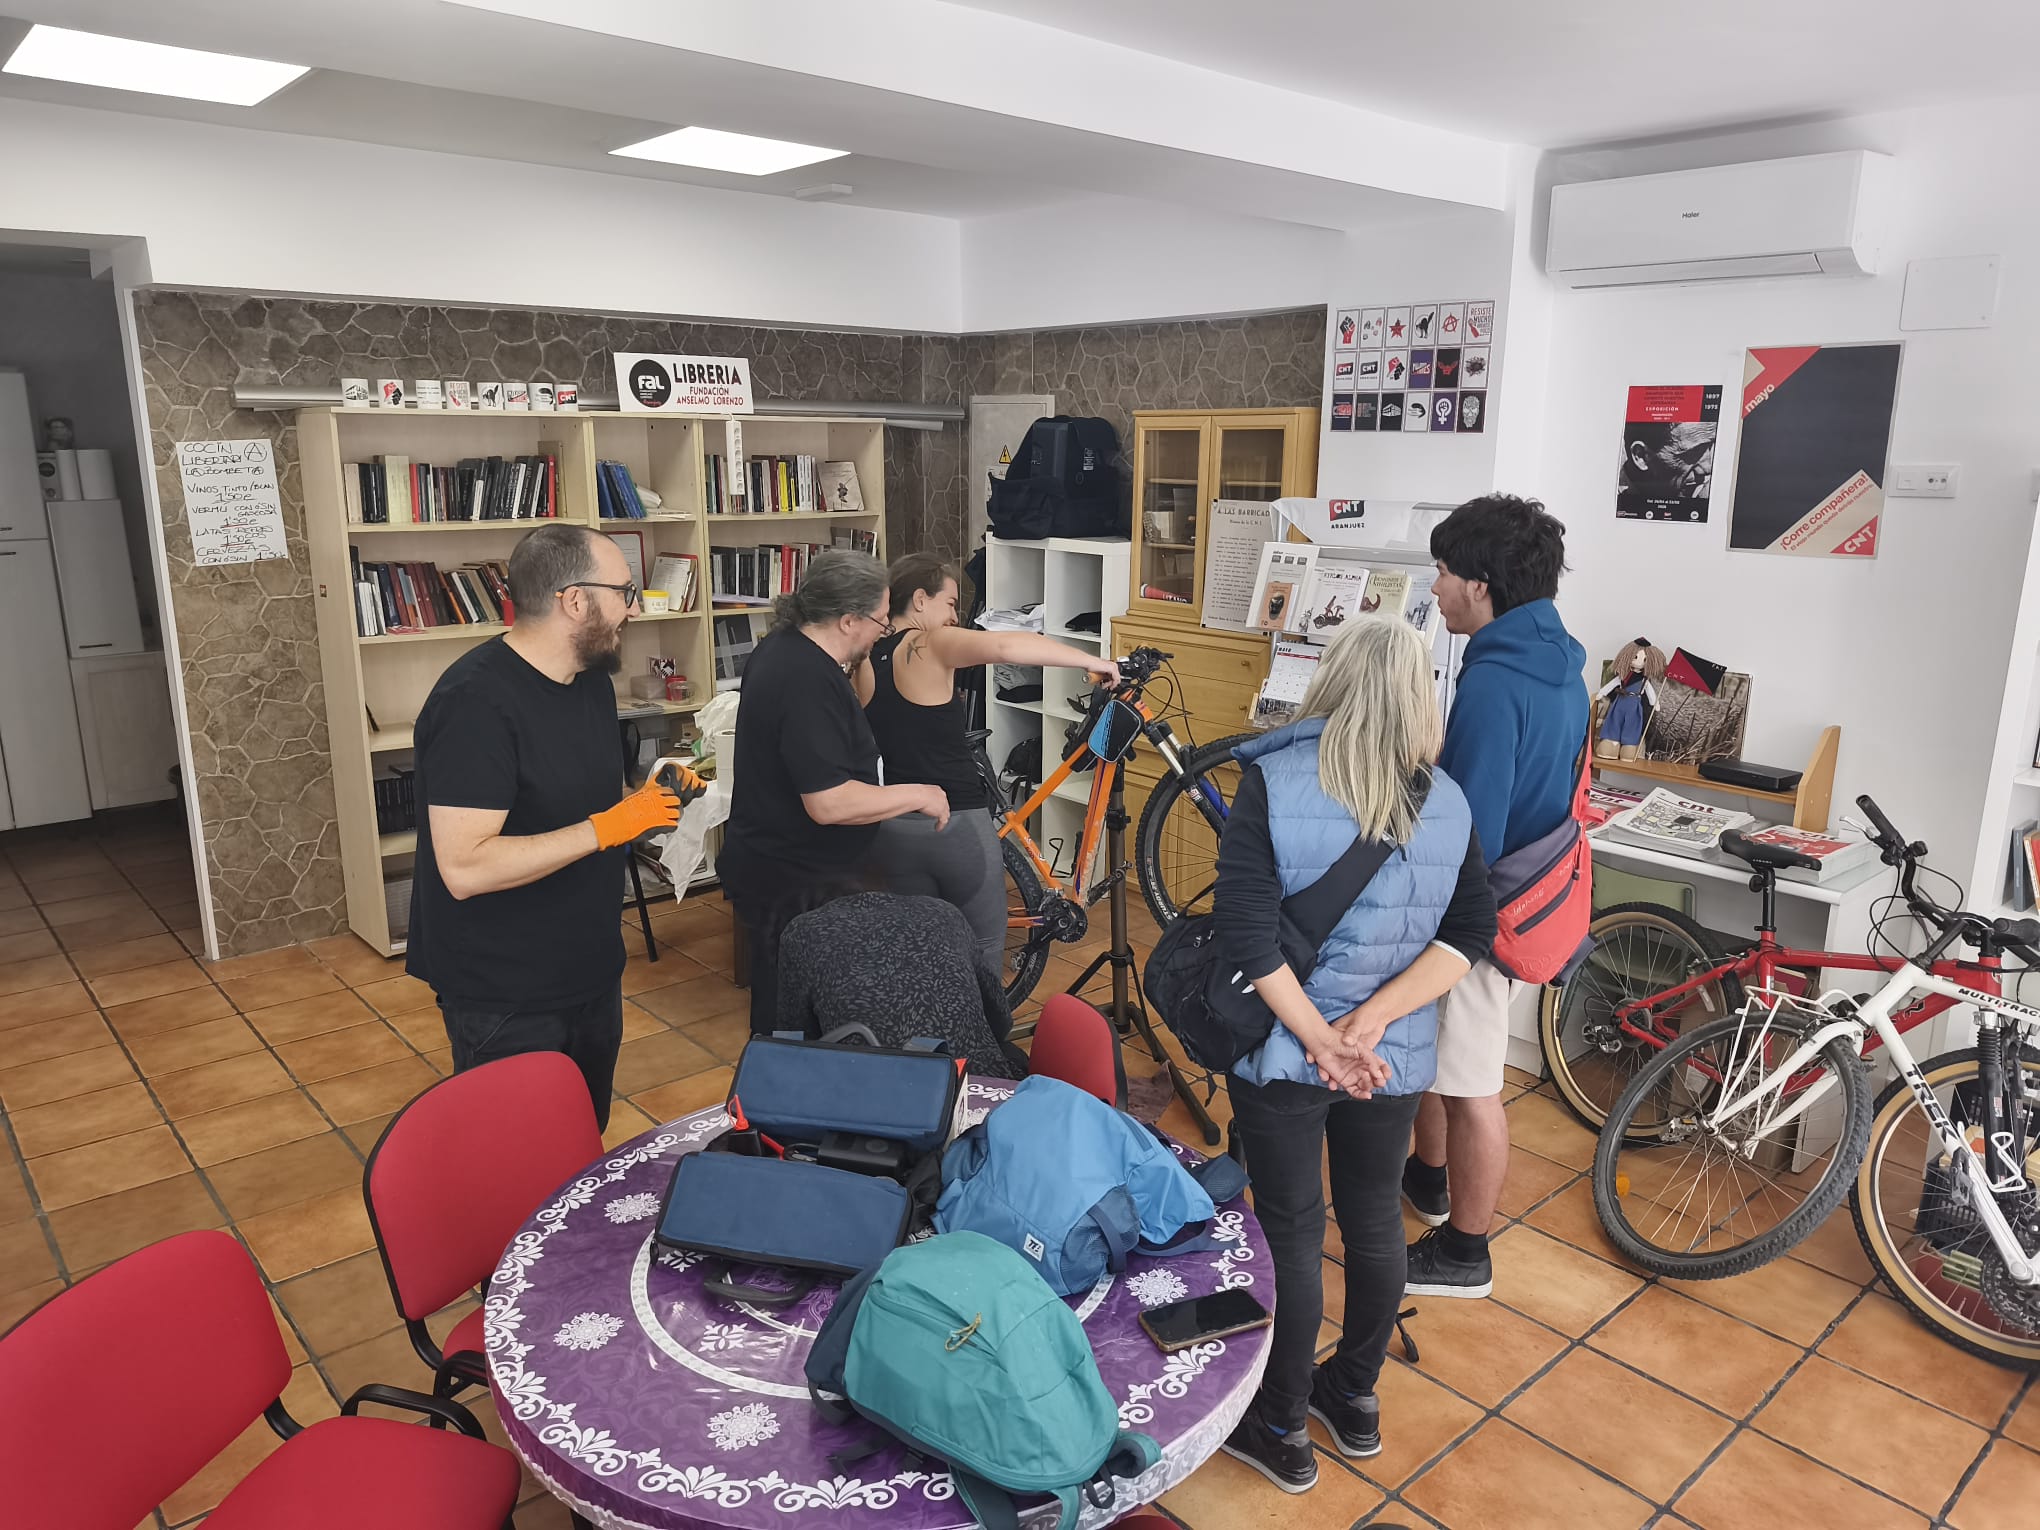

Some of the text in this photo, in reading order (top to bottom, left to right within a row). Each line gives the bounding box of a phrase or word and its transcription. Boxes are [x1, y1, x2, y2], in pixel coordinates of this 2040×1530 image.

[1362, 364, 1376, 372] CNT
[673, 363, 742, 385] LIBRERIA
[690, 386, 729, 396] FUNDACIÓN
[677, 396, 744, 406] ANSELMO LORENZO
[1745, 384, 1775, 413] mayo
[187, 483, 219, 493] VINOS
[234, 504, 253, 512] CON
[1334, 500, 1361, 513] CNT
[1781, 473, 1868, 550] ¡Corre compañera!
[1238, 508, 1270, 517] BARRICAD
[196, 528, 231, 537] LATAS
[1844, 526, 1874, 553] CNT
[1667, 672, 1686, 681] CNT
[1606, 787, 1641, 797] cnt
[1678, 800, 1715, 814] cnt
[1958, 987, 2040, 1018] MULTITRAC
[1906, 1064, 1959, 1143] TREK
